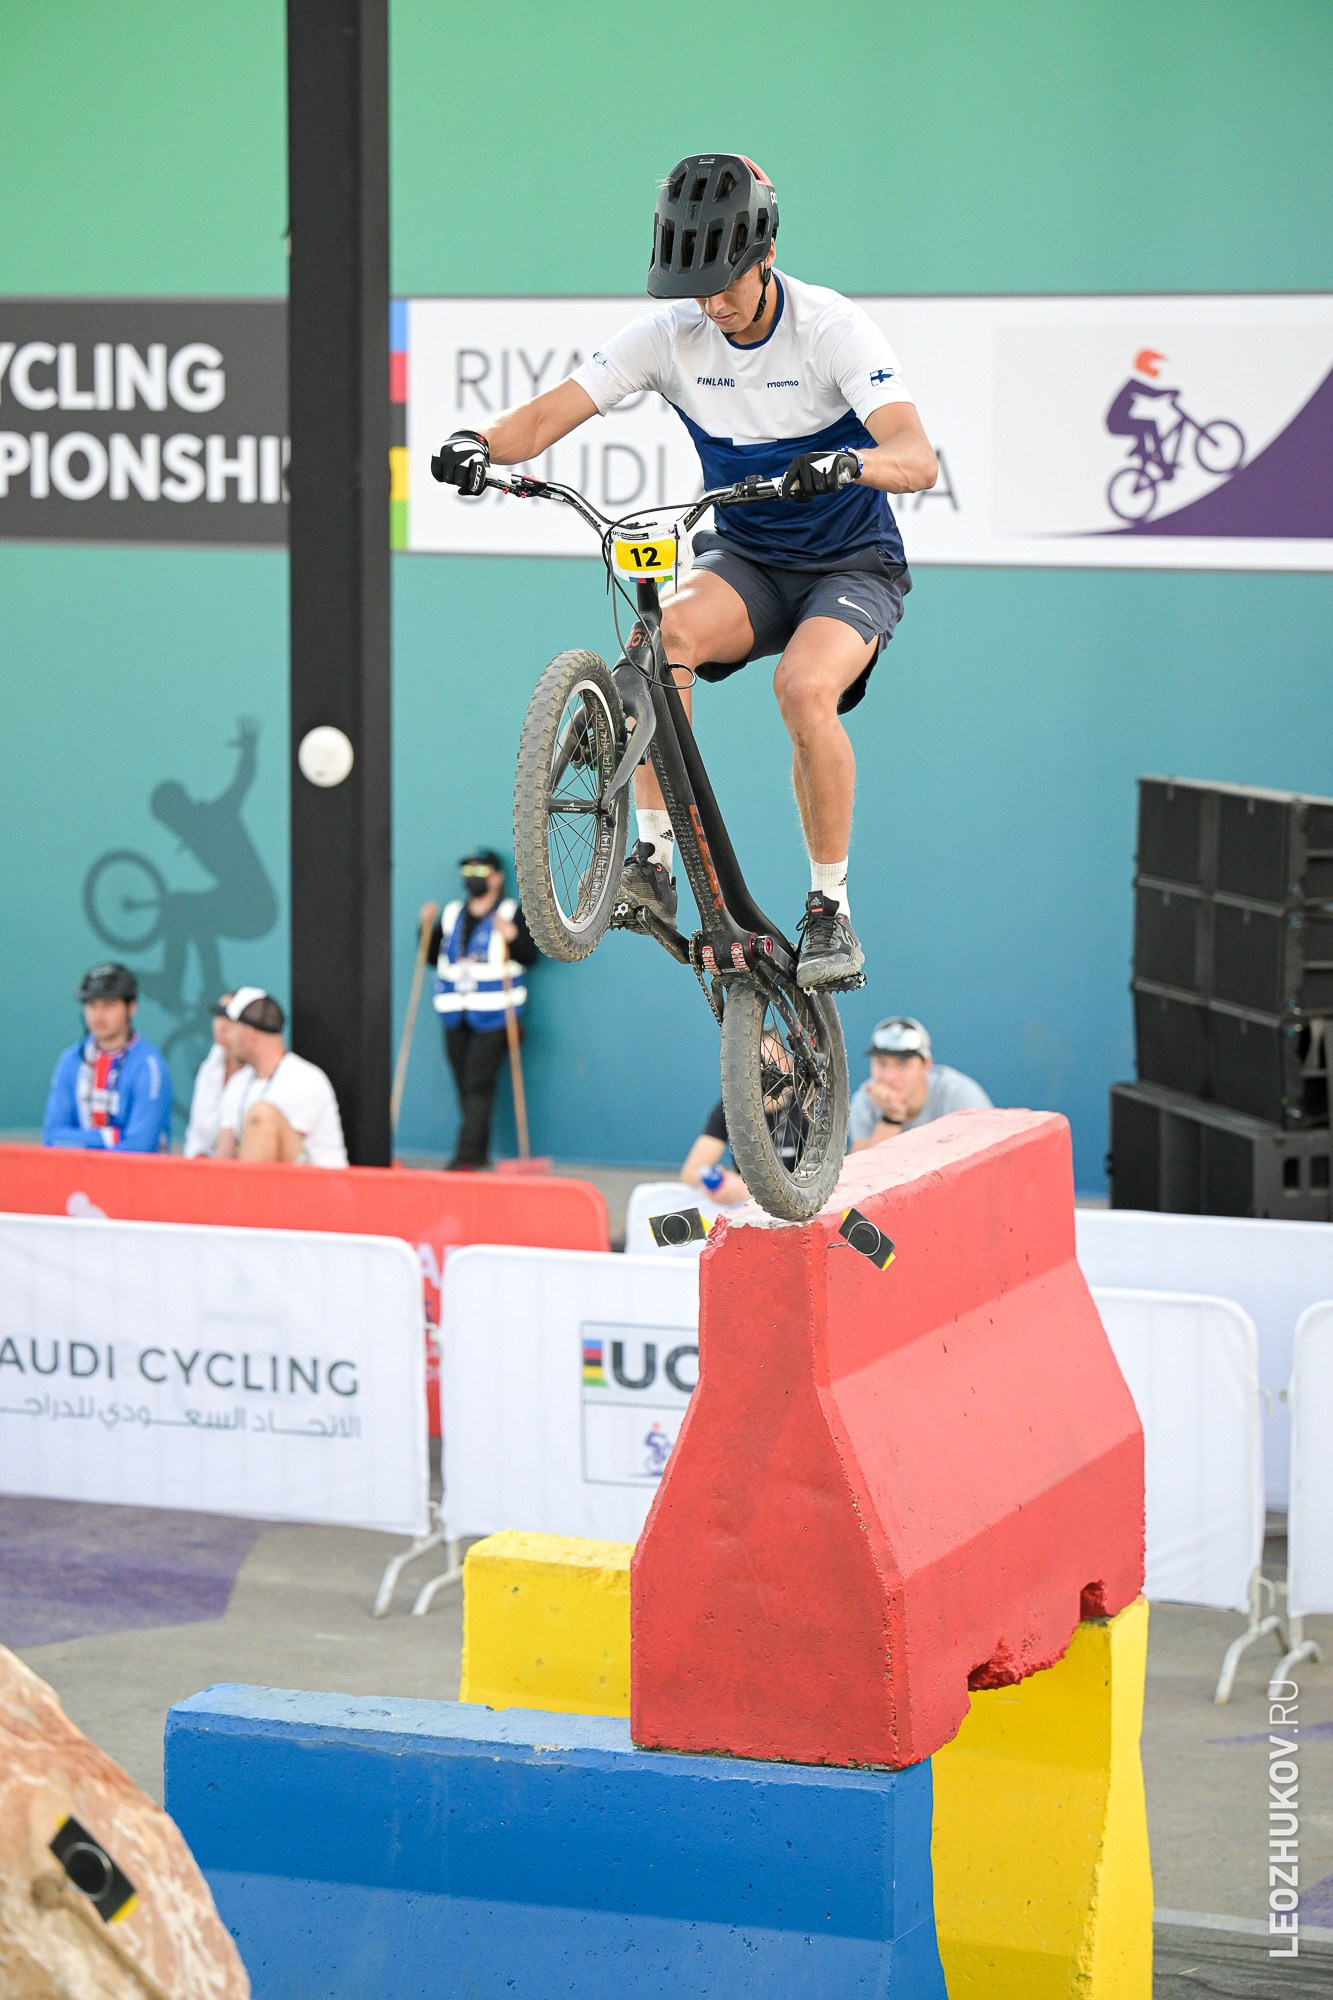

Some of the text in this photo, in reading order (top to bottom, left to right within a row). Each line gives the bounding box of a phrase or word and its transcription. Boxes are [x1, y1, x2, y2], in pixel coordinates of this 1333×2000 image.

[0, 341, 225, 413] CLING
[697, 377, 735, 388] FINLAND
[0, 431, 291, 504] PIONSHI
[630, 547, 661, 567] 12
[0, 1337, 359, 1398] AUDI CYCLING
